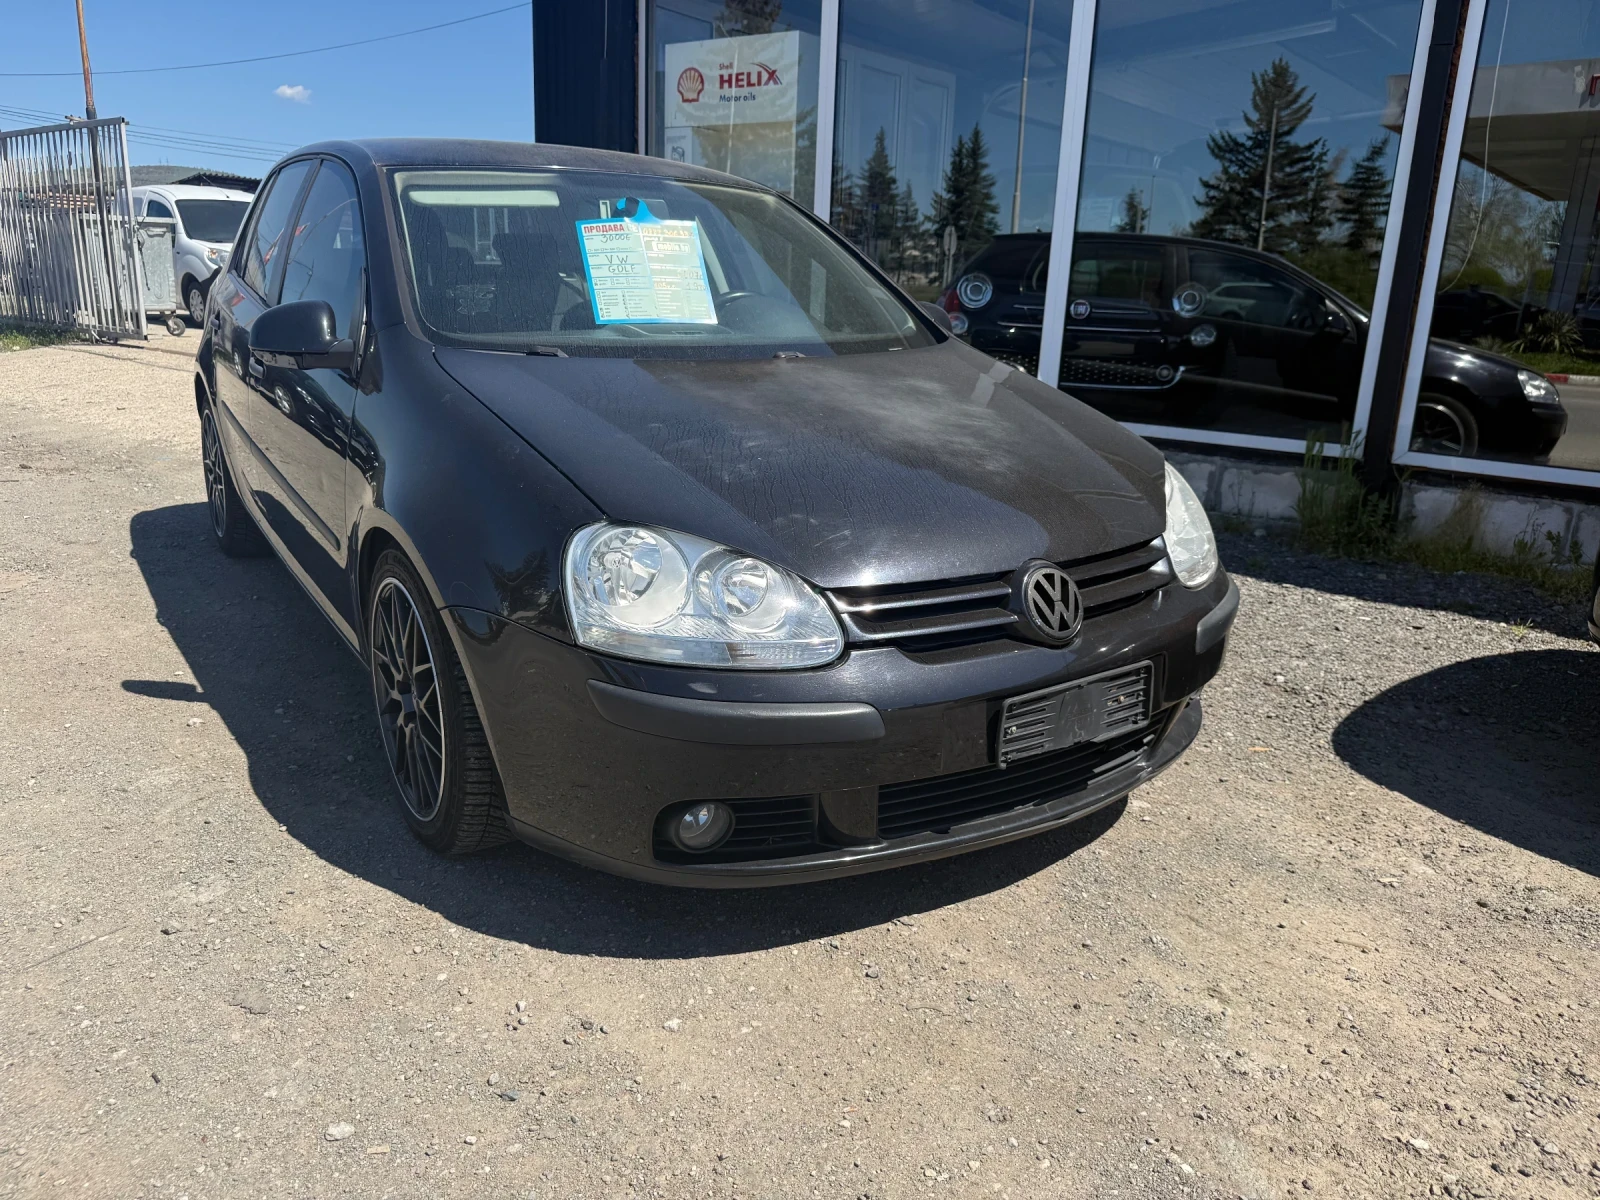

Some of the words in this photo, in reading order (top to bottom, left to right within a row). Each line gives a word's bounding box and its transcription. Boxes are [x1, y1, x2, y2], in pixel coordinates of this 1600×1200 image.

[719, 62, 734, 71] Shell
[719, 67, 780, 90] HELIX
[719, 94, 742, 103] Motor
[743, 92, 756, 102] oils
[583, 224, 625, 234] ПРОДАВА
[607, 265, 635, 273] GOLF
